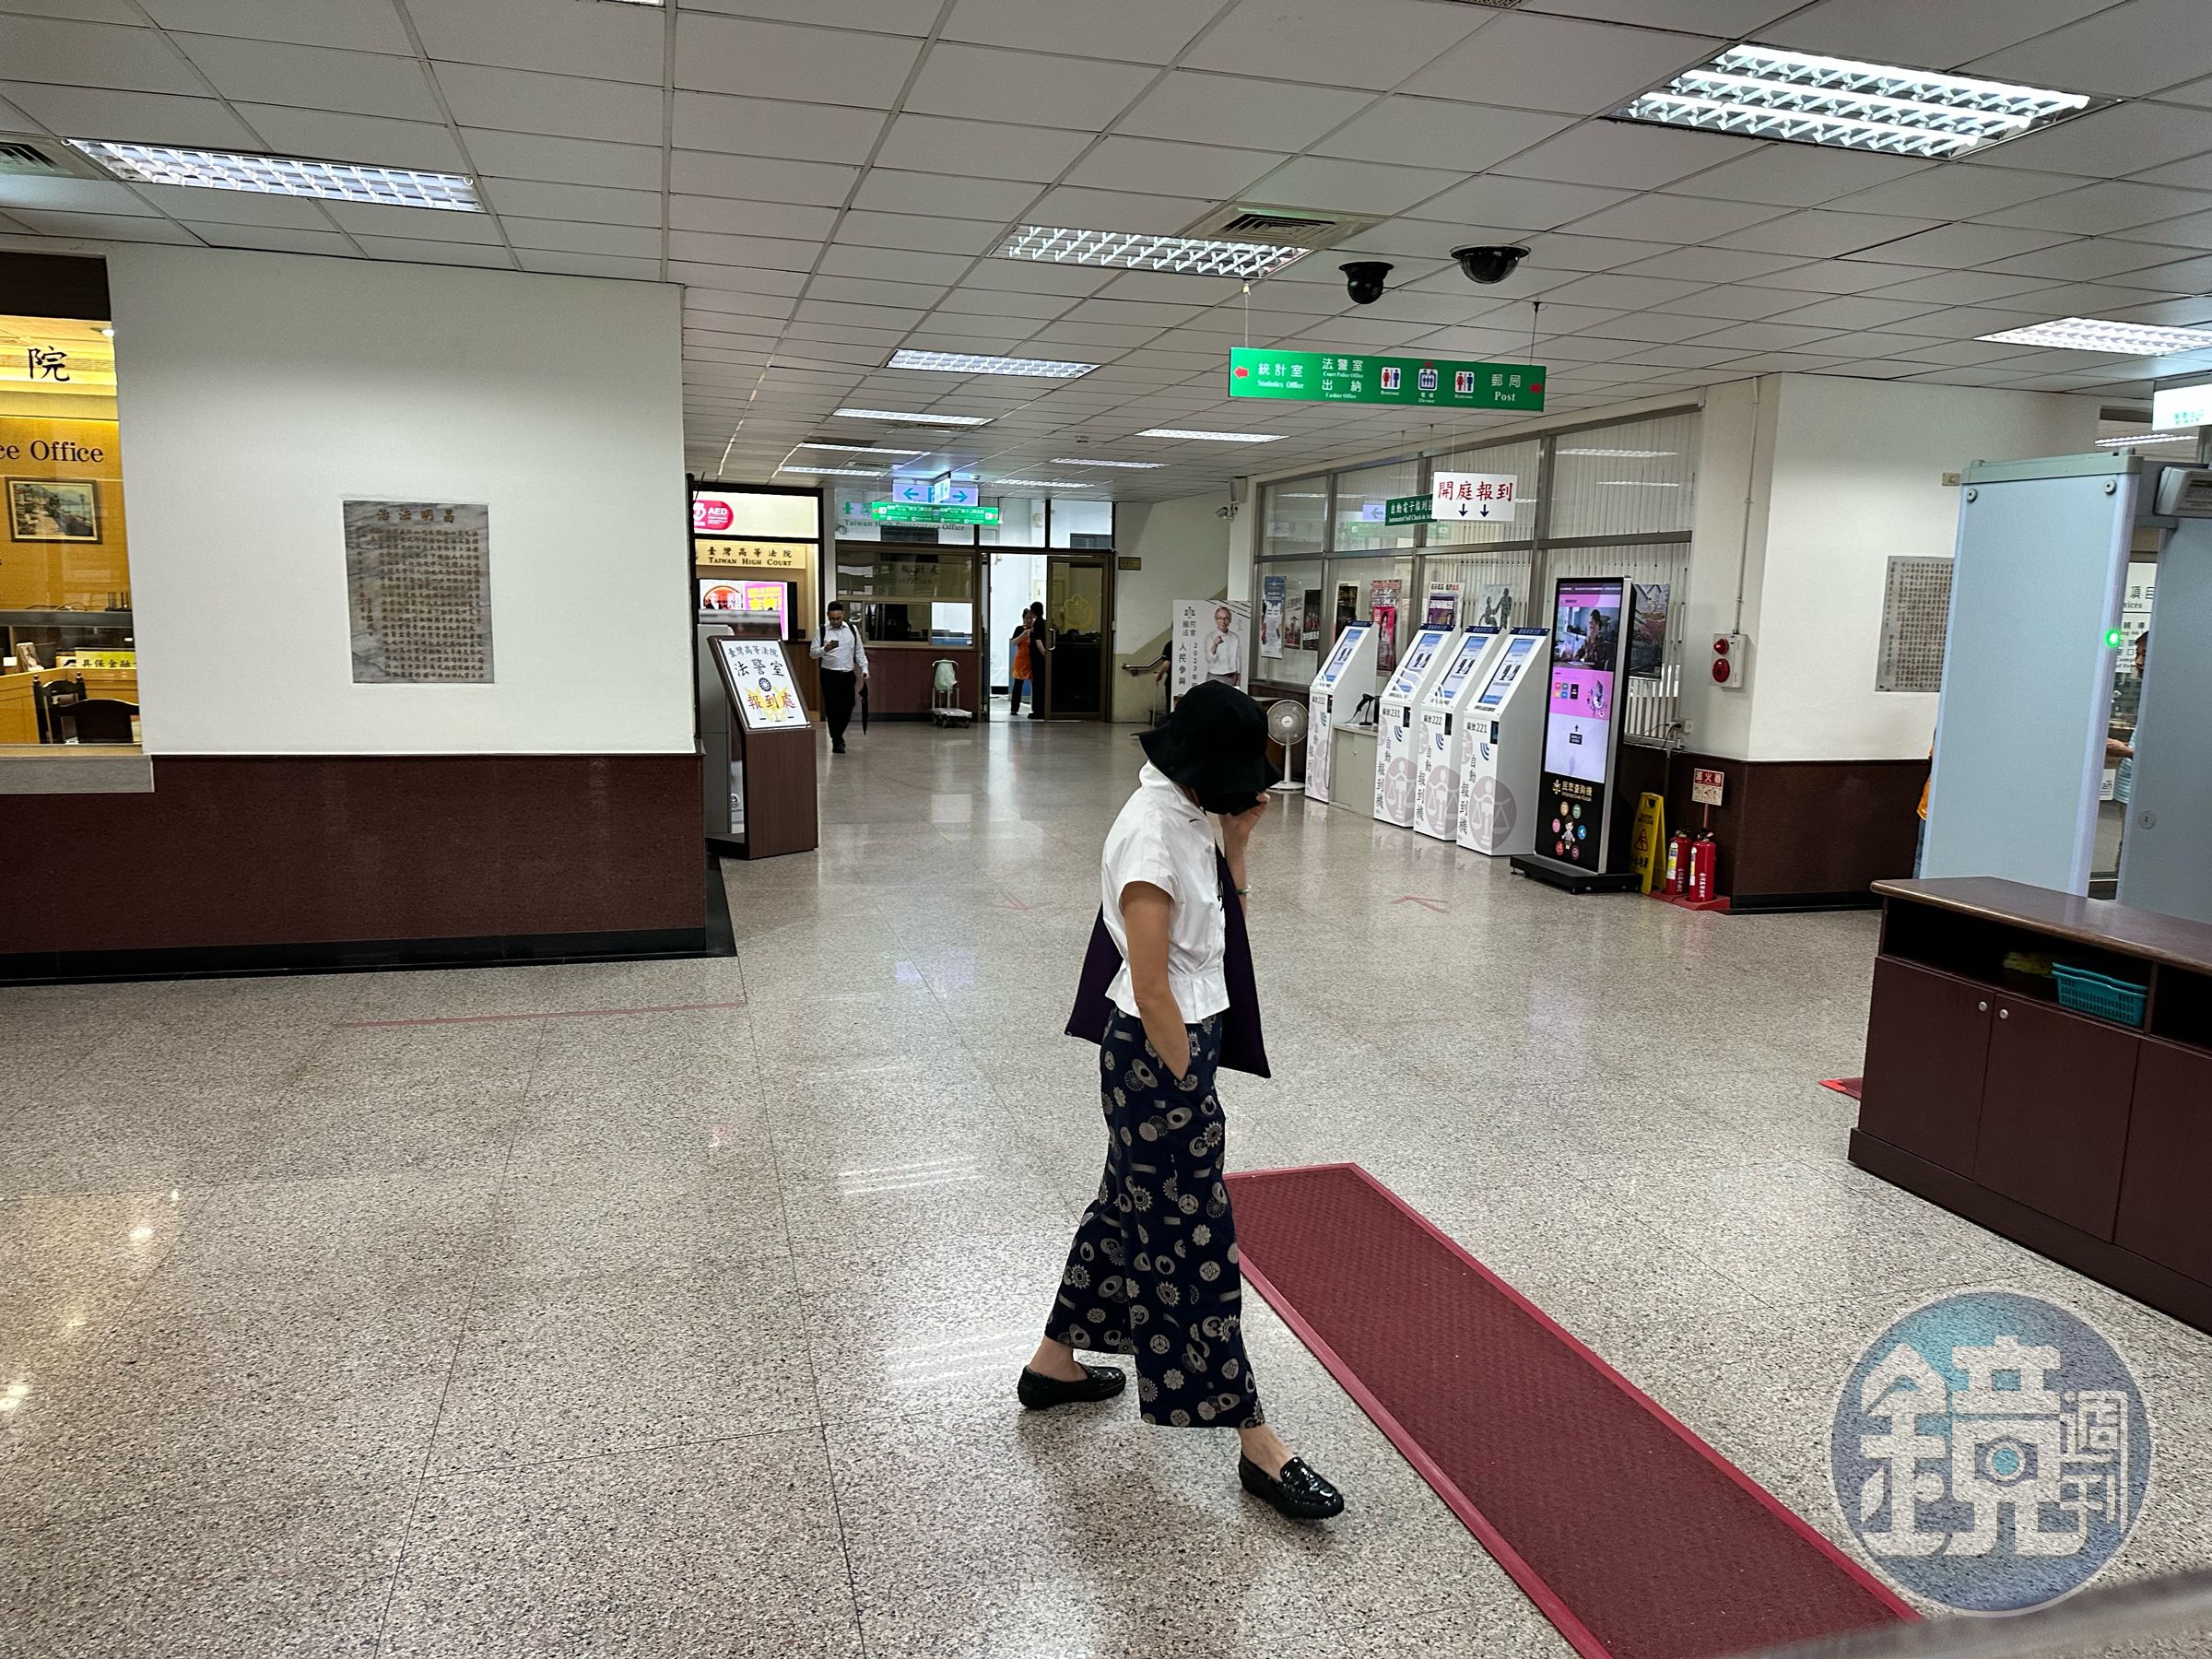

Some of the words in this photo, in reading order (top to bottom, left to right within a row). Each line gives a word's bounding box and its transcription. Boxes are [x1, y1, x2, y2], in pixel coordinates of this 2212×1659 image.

[28, 345, 70, 382] 院
[1257, 362, 1303, 378] 統計室
[1257, 380, 1284, 388] Statistics
[1286, 381, 1304, 389] Office
[1322, 379, 1362, 393] 出納
[1490, 373, 1521, 387] 郵局
[1494, 392, 1516, 402] Post
[30, 440, 104, 463] Office
[1438, 480, 1513, 501] 開庭報到
[845, 519, 873, 527] Taiwan
[942, 523, 965, 531] Office
[708, 546, 792, 558] 臺灣高等法院
[708, 556, 736, 564] TAIWAN
[728, 645, 779, 657] 臺灣高等法院
[734, 658, 784, 677] 法警室
[747, 692, 795, 710] 報到處
